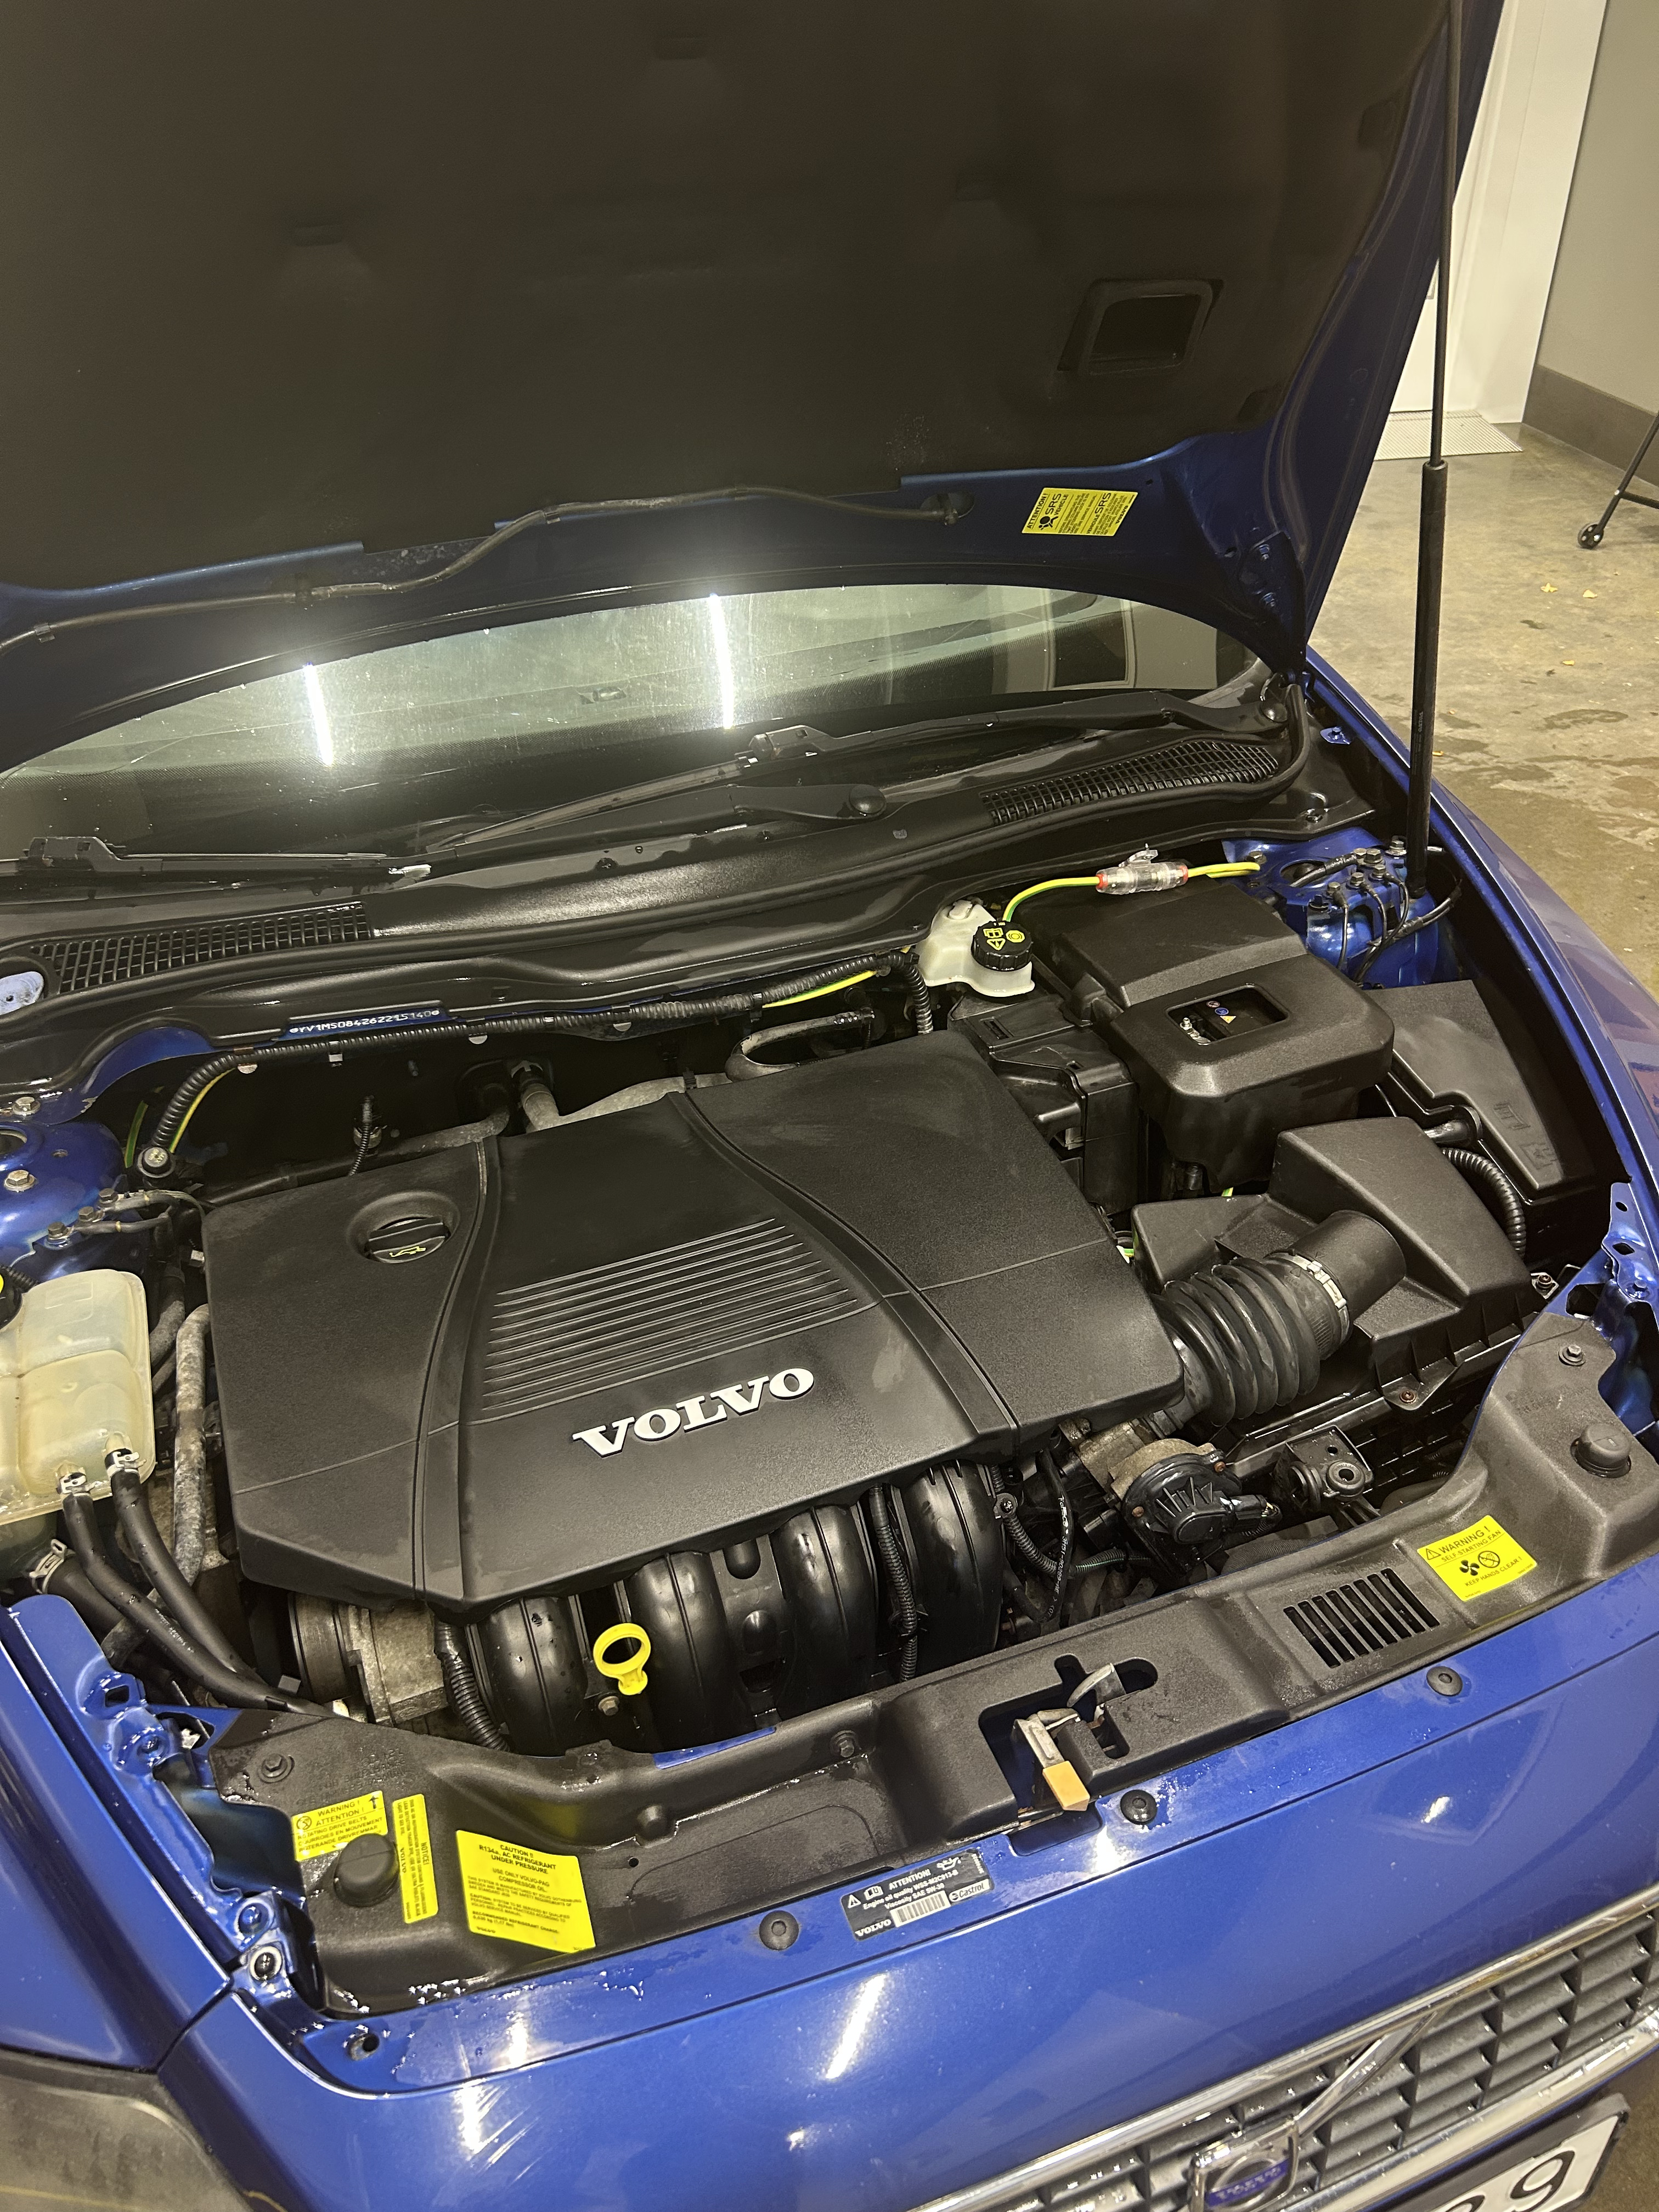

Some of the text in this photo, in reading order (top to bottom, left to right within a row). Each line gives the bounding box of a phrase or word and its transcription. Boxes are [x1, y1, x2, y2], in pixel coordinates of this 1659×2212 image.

[1045, 493, 1062, 515] SRS
[1054, 494, 1069, 515] VEHICLE
[1094, 493, 1111, 514] SRS
[1115, 505, 1128, 524] VOLVO
[572, 1368, 815, 1458] VOLVO
[1438, 1530, 1485, 1554] WARNING
[1441, 1530, 1502, 1562] SELF-STARTING FAN
[1464, 1578, 1480, 1587] KEEP
[1481, 1569, 1500, 1581] HANDS
[1499, 1559, 1519, 1572] CLEAR
[316, 1809, 360, 1826] ATTENTION
[318, 1802, 356, 1817] WARNING
[298, 1832, 334, 1846] CURROIES
[346, 1817, 383, 1832] MOUVEMENT
[329, 1822, 347, 1831] DRIVE
[348, 1816, 368, 1825] BELTS
[421, 1842, 430, 1865] NOTICE!
[500, 1844, 528, 1857] CAUTION
[491, 1854, 549, 1874] UNDER PRESSURE
[512, 1854, 556, 1870] REFRIGERANT
[499, 1876, 536, 1889] COMPRESSOR
[889, 1869, 932, 1891] ATTENTION!
[958, 1882, 985, 1898] Castrol
[862, 1897, 885, 1910] Engine
[885, 1893, 894, 1901] oil
[894, 1887, 914, 1900] quality
[884, 1896, 912, 1909] Viscosity
[913, 1889, 927, 1899] SAE
[855, 1919, 891, 1937] VOLVO
